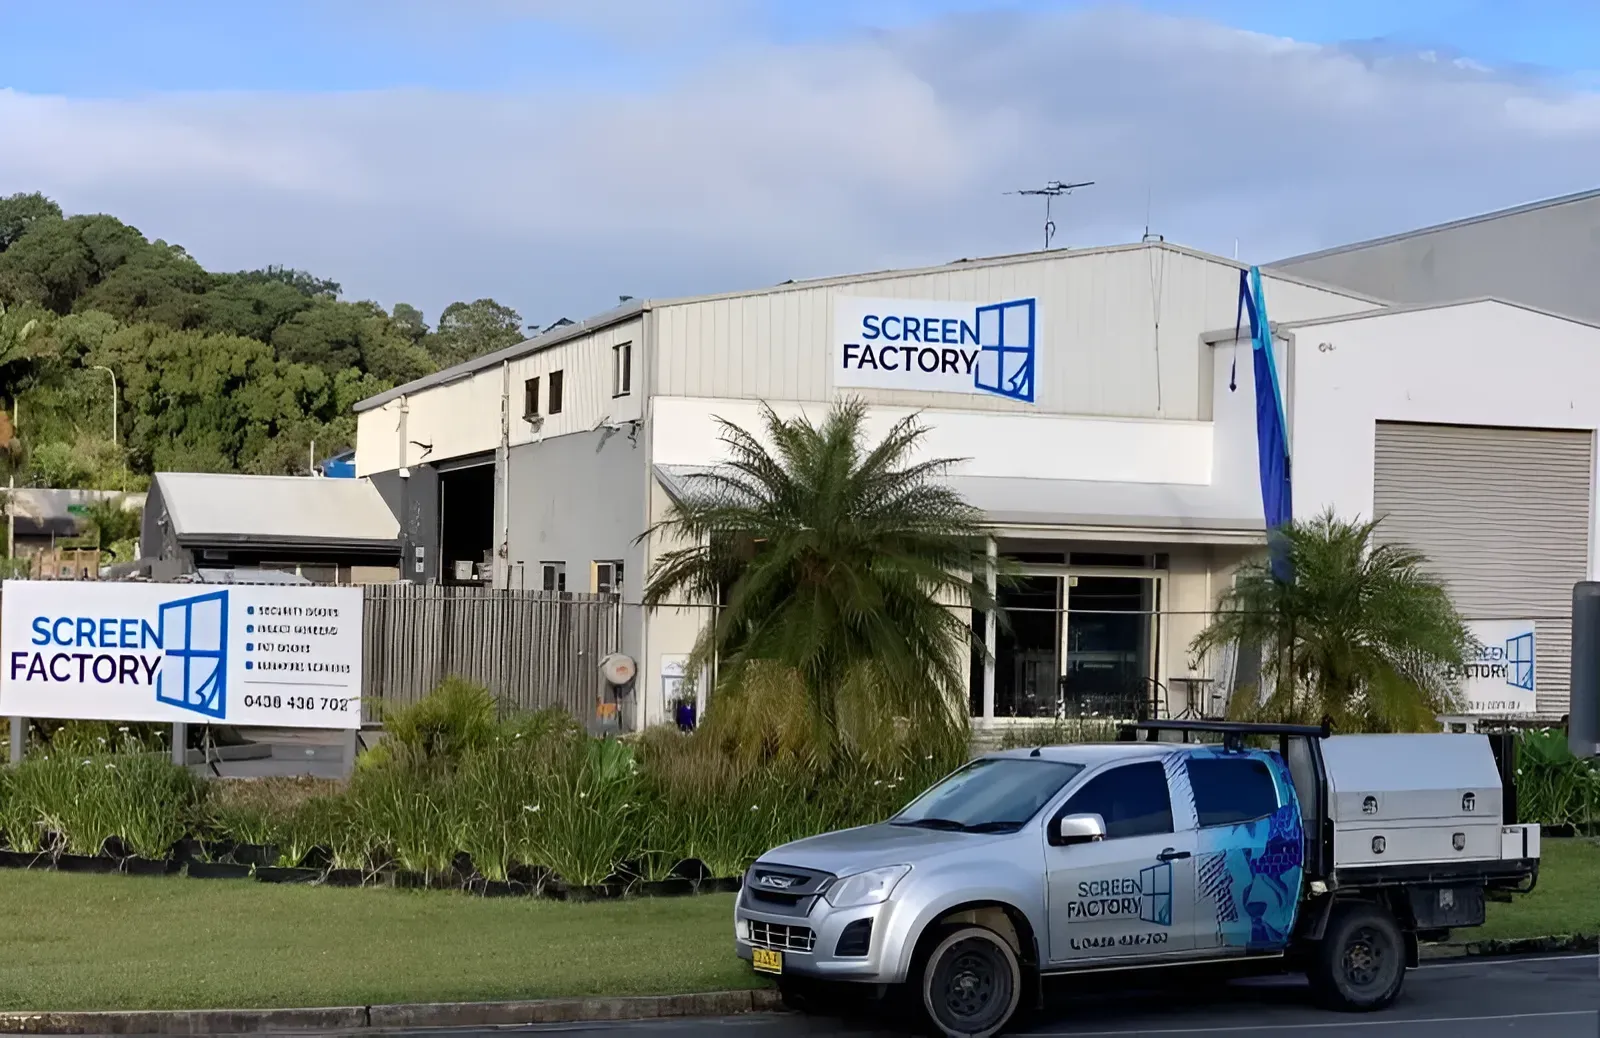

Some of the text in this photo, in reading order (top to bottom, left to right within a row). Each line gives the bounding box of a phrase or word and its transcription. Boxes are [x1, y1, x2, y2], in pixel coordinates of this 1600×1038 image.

[862, 315, 980, 345] SCREEN
[843, 344, 980, 374] FACTORY
[31, 616, 164, 649] SCREEN
[11, 652, 162, 686] FACTORY
[1078, 879, 1142, 898] SCREEN
[1068, 896, 1142, 918] FACTORY
